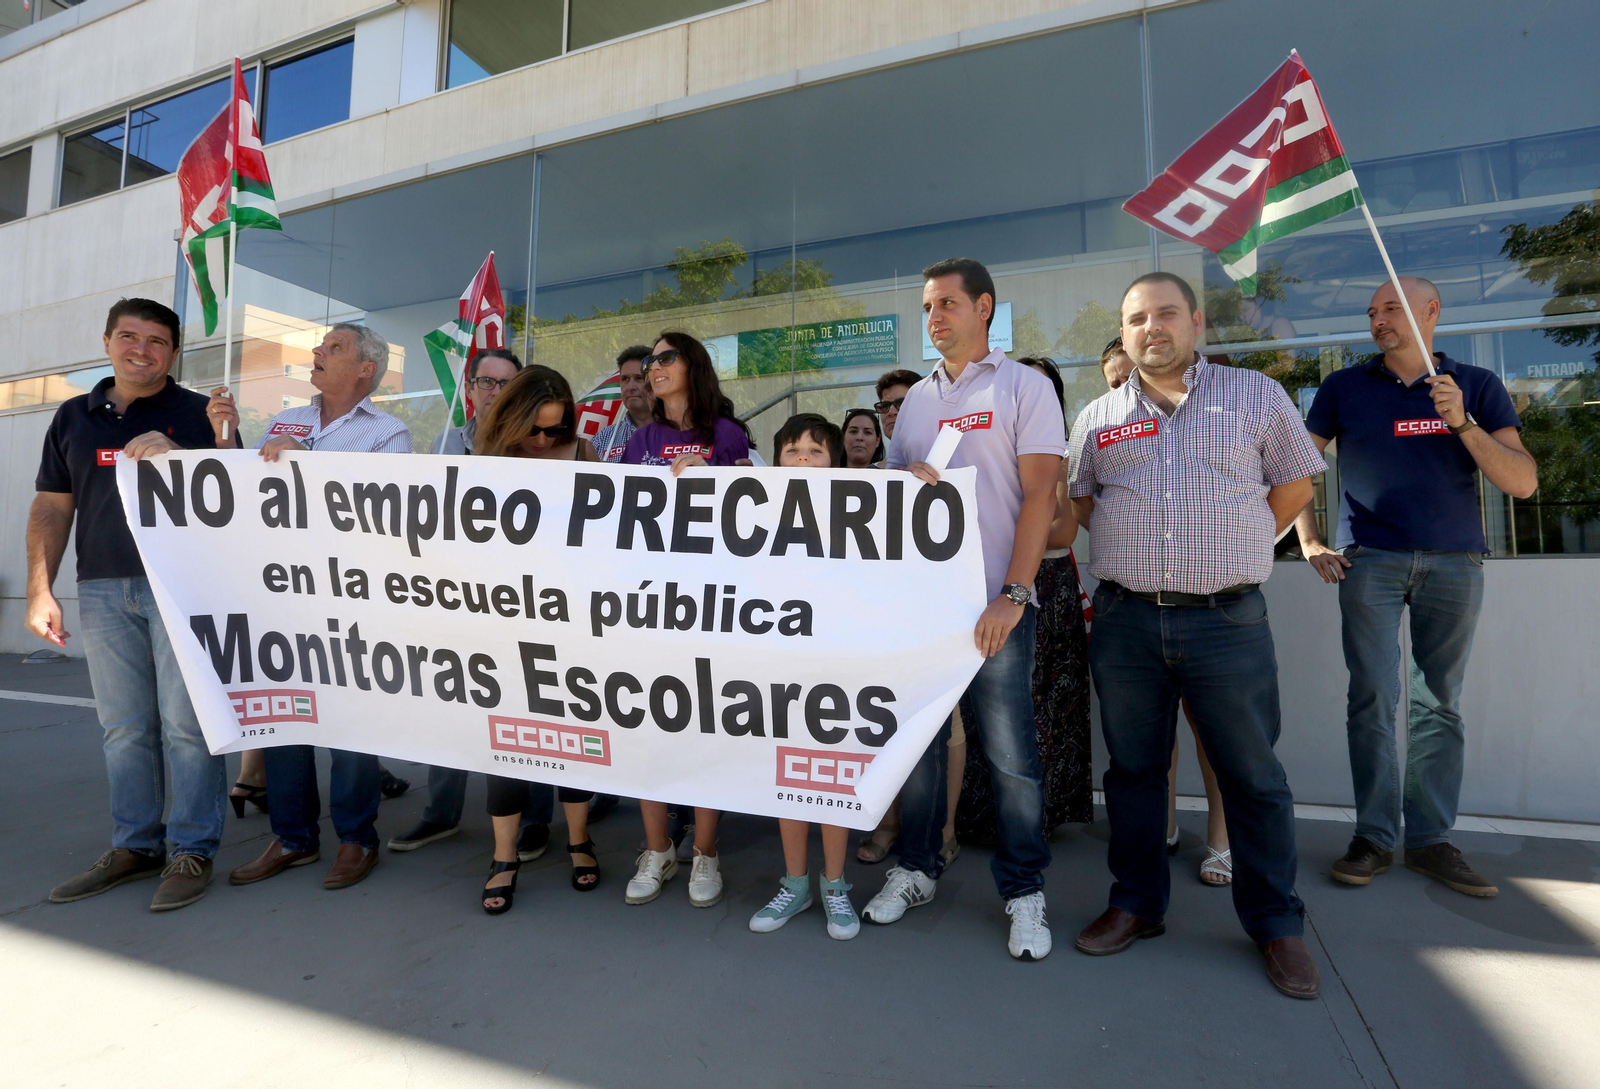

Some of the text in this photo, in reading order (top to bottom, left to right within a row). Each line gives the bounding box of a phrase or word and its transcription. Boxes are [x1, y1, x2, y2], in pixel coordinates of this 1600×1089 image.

[785, 329, 816, 342] JUNTA
[821, 326, 833, 338] DE
[1527, 361, 1585, 378] ENTRADA
[273, 424, 304, 433] CCOO
[1099, 423, 1142, 444] CCOO
[1399, 421, 1442, 432] CCOO
[664, 445, 701, 455] CCOO
[137, 458, 965, 562] NO al empleo PRECARIO
[262, 557, 814, 637] en la escuela pública
[190, 613, 898, 748] Monitoras Escolares
[495, 723, 583, 755] CCOO
[493, 754, 566, 771] enseñanza
[784, 754, 869, 784] CCO
[777, 792, 862, 811] enseñanza
